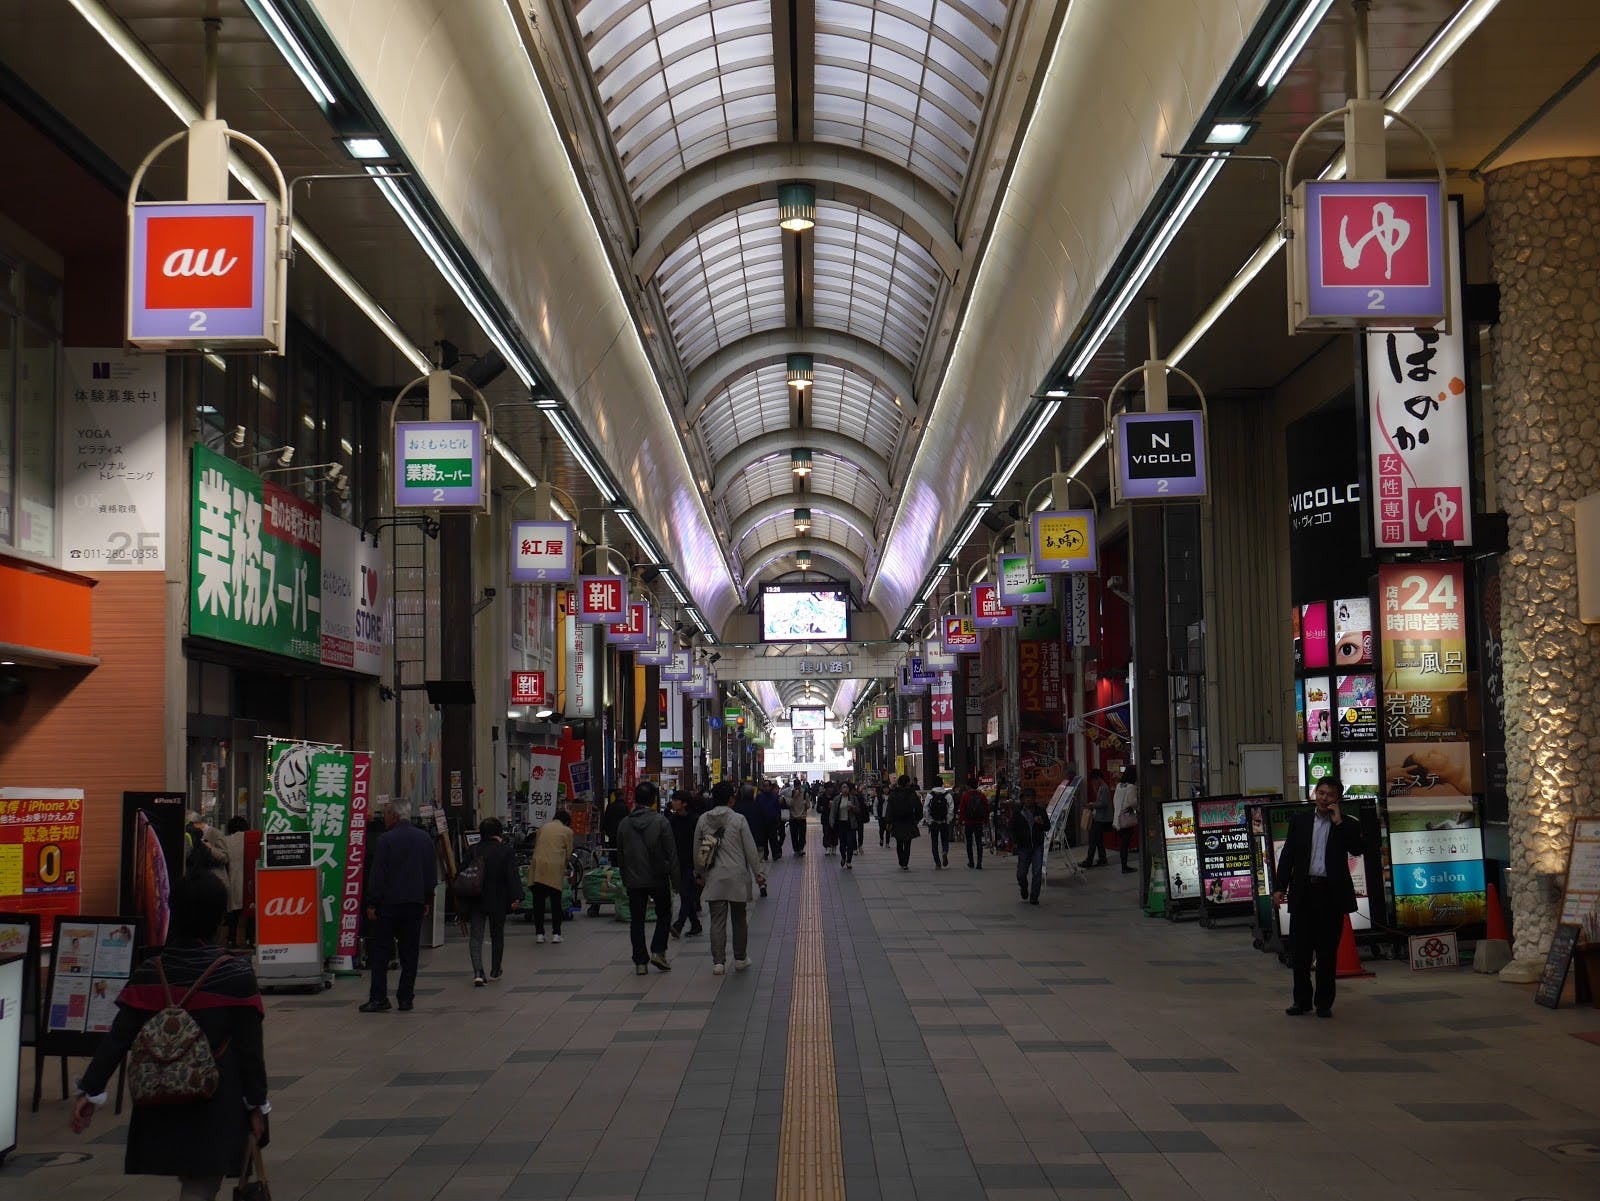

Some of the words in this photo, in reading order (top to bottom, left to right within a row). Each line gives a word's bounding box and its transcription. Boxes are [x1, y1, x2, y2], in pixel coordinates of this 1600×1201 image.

[1338, 201, 1411, 280] ゆ
[161, 247, 238, 278] au
[1366, 289, 1386, 310] 2
[188, 310, 207, 332] 2
[74, 389, 157, 404] 体験募集中!
[77, 429, 112, 439] YOGA
[1151, 432, 1170, 449] N
[78, 446, 123, 455] ピラティス
[1132, 453, 1192, 464] VICOLO
[77, 461, 127, 471] パーソナル
[406, 463, 471, 482] 業務スーパー
[98, 471, 154, 481] トレーニング
[431, 488, 445, 502] 2
[1157, 479, 1169, 493] 2
[1381, 456, 1402, 541] 女性専用
[98, 504, 136, 513] 資格取得
[1415, 490, 1458, 539] ゆ
[83, 548, 159, 560] 011-280-0358
[107, 531, 161, 565] 2F
[197, 467, 321, 633] 業務スーパー
[521, 539, 564, 556] 紅屋
[1060, 559, 1070, 569] 2
[537, 568, 546, 579] 2
[588, 582, 616, 611] 靴
[1022, 594, 1029, 602] 2
[1386, 586, 1399, 612] 店内
[1400, 574, 1458, 611] 24
[355, 609, 382, 643] STORE
[599, 613, 606, 621] 2
[991, 617, 999, 625] 2
[1386, 613, 1459, 632] 時間営業
[1419, 650, 1464, 675] 風呂
[518, 675, 537, 694] 靴
[1386, 692, 1432, 716] 岩盤
[1387, 716, 1409, 738] 浴
[1391, 774, 1440, 790] エステ
[28, 800, 65, 812] iPhone
[67, 799, 81, 811] XS
[23, 825, 81, 843] 緊急告知!
[39, 844, 62, 884] 0
[65, 870, 76, 884] 円
[339, 764, 369, 949] プロの品質とプロの価格
[1430, 871, 1466, 883] salon
[264, 896, 313, 917] au
